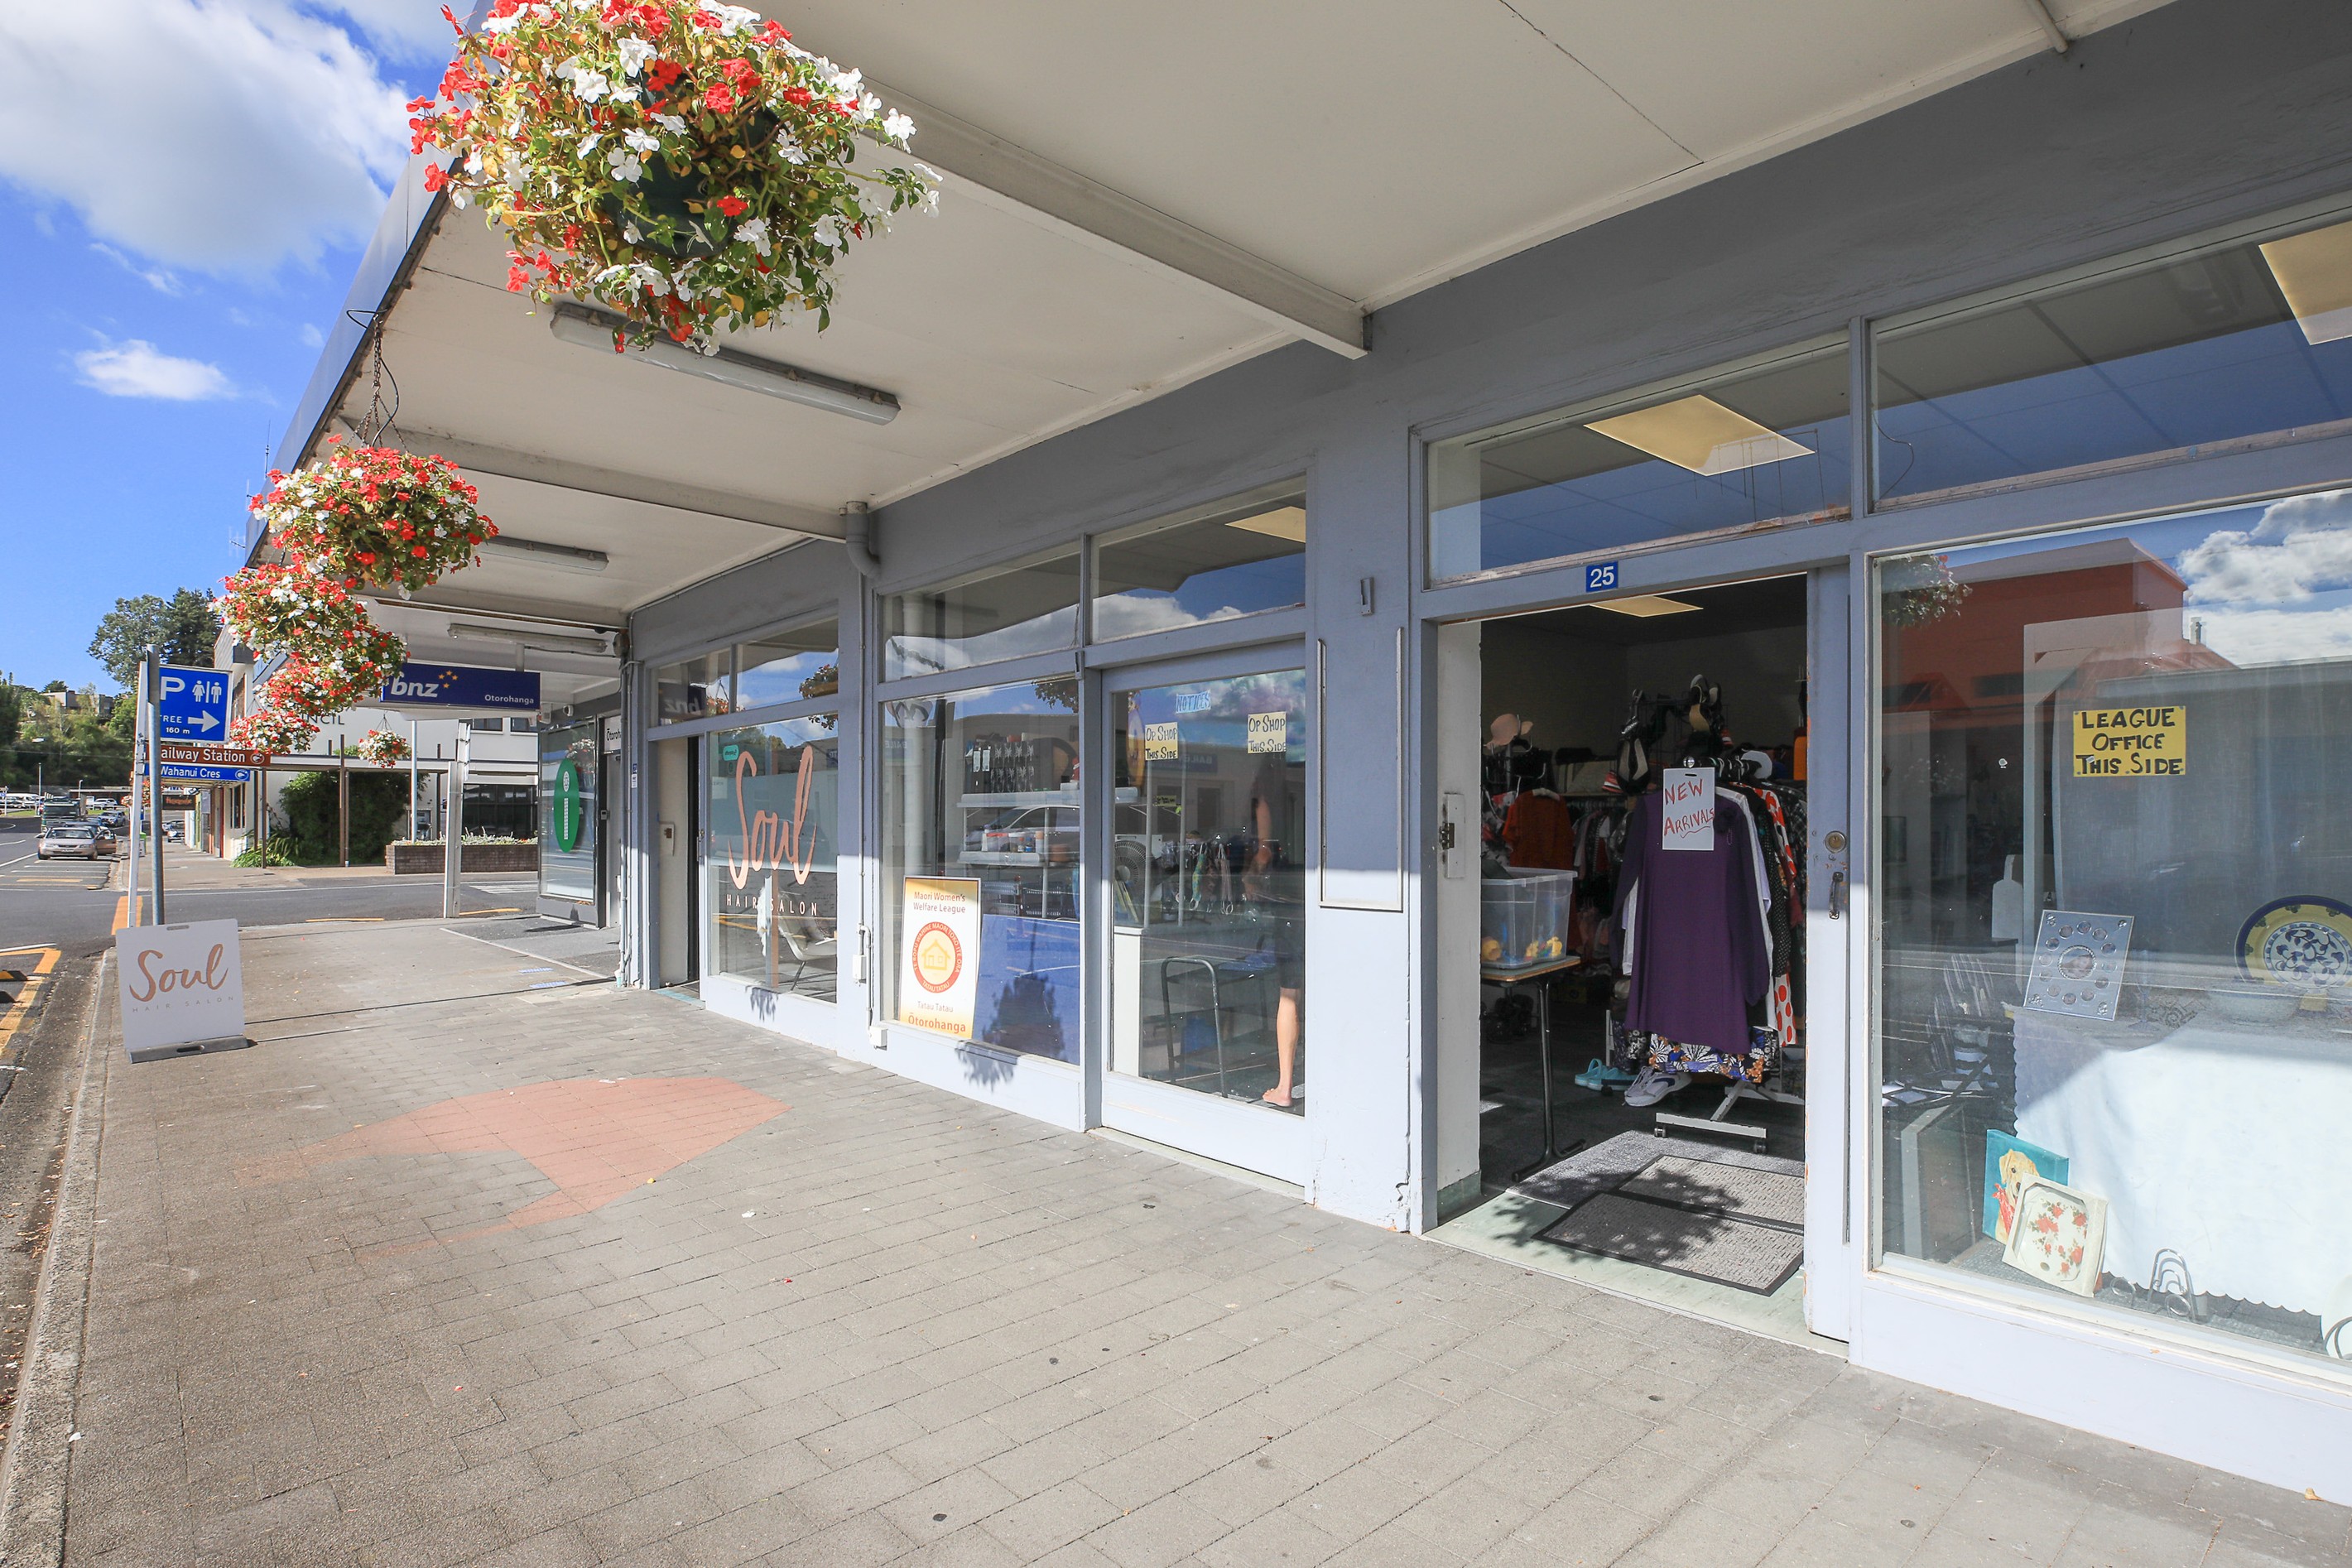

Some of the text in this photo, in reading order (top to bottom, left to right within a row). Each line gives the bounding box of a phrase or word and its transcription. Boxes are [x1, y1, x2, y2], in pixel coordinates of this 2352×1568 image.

[1590, 565, 1614, 588] 25
[160, 676, 185, 700] P
[391, 674, 439, 698] bnz
[484, 694, 535, 705] Otorohanga
[160, 714, 182, 724] REE
[2081, 708, 2176, 729] LEAGUE
[2092, 733, 2165, 751] OFFICE
[161, 747, 246, 762] ailway Station
[1161, 747, 1176, 759] SIDE
[2075, 752, 2183, 775] THIS SIDE
[161, 766, 221, 778] Wahanui Cres
[1665, 779, 1703, 806] NEW
[729, 745, 817, 890] Soul
[1664, 807, 1715, 836] ARRIVALS
[727, 894, 817, 916] HAIR SALON
[914, 892, 965, 902] Maori Women's
[913, 902, 966, 914] Welfare League
[129, 943, 229, 1002] Soul
[132, 996, 233, 1012] HAIR SALON
[918, 1001, 954, 1012] Tatau Tatau
[908, 1012, 966, 1034] Ōtorohanga
